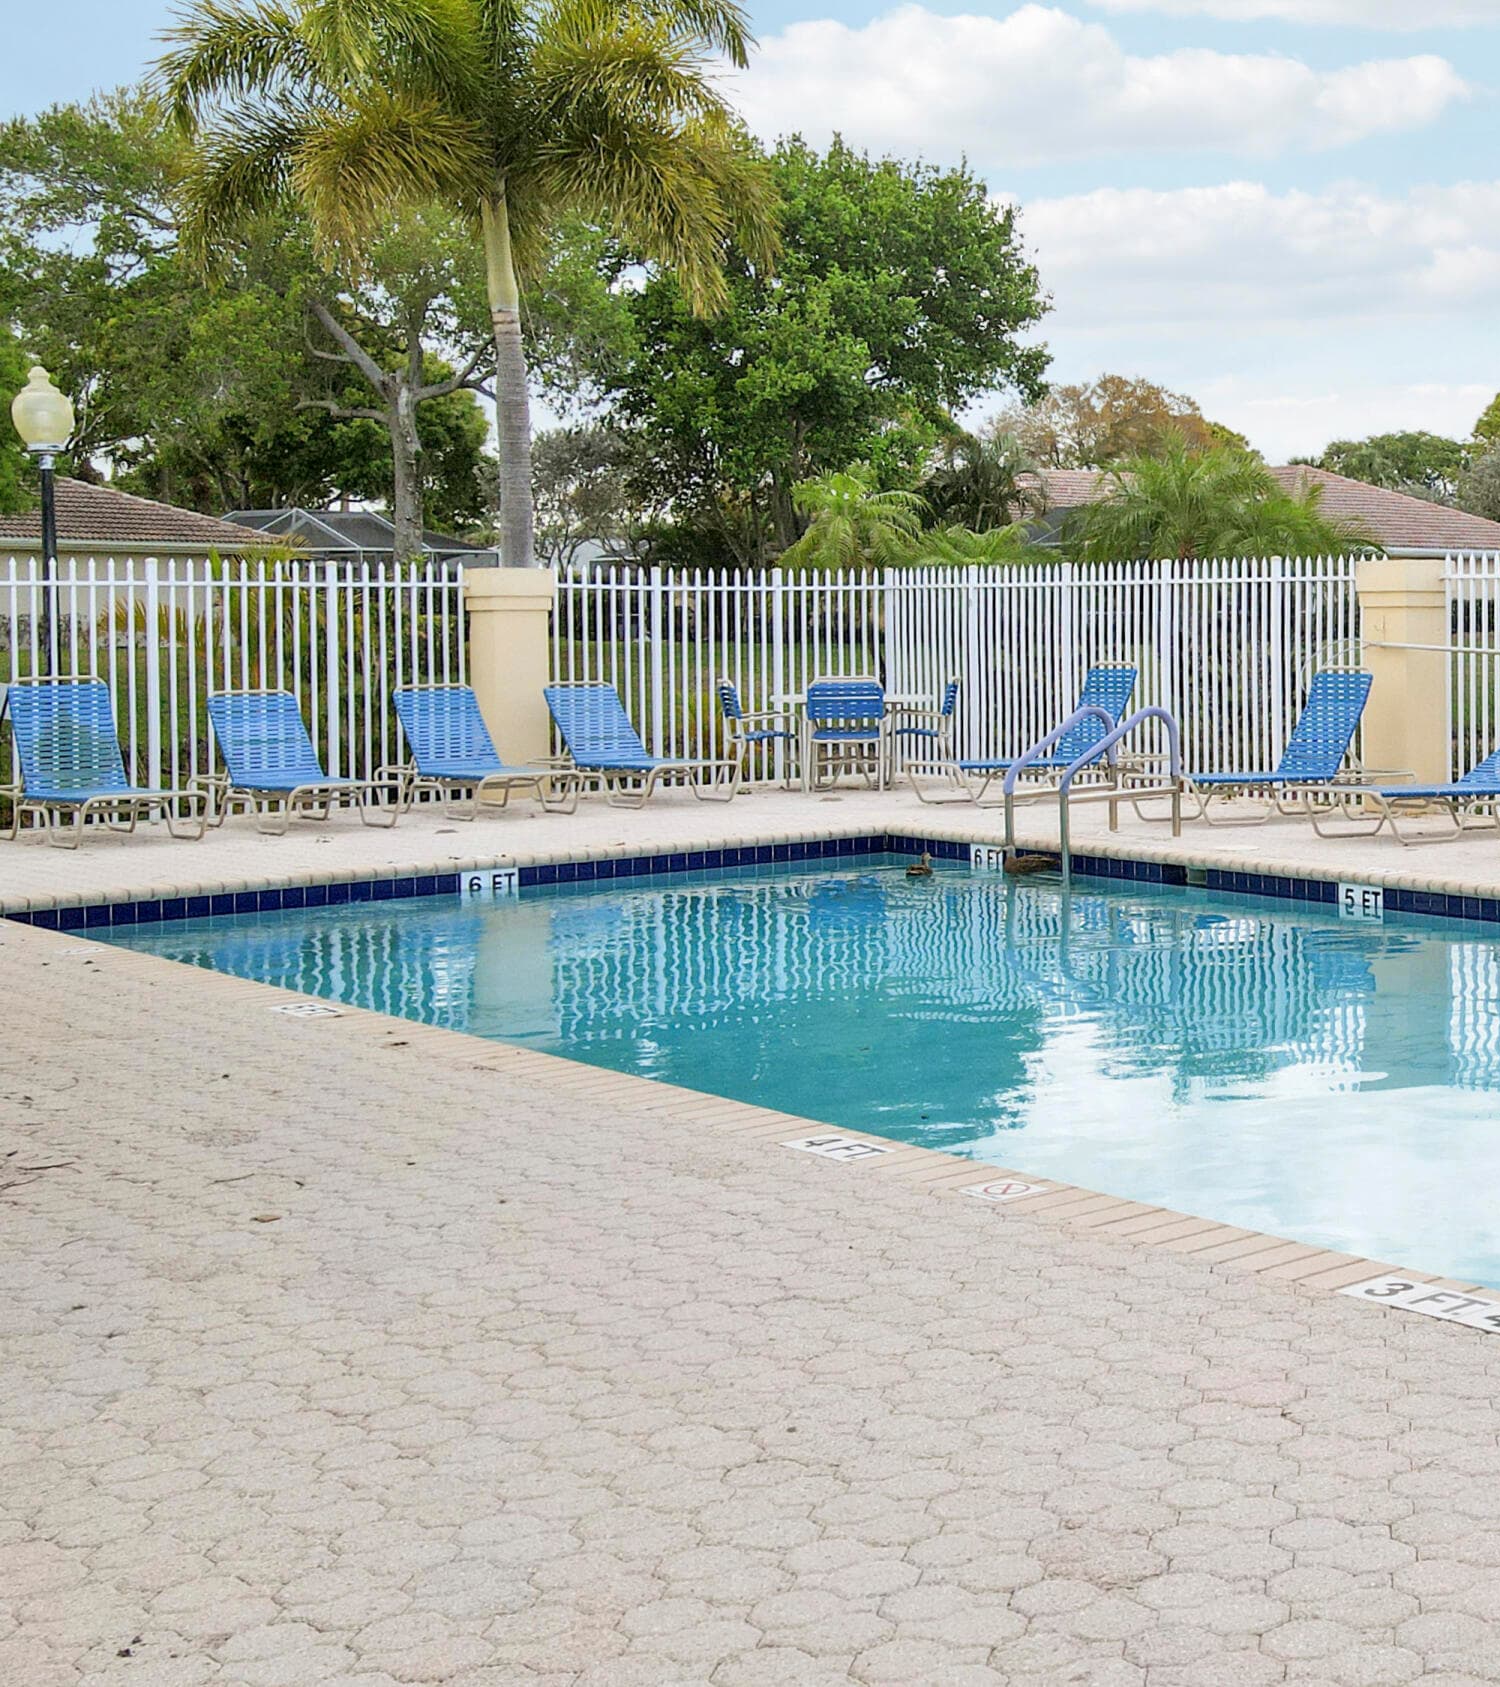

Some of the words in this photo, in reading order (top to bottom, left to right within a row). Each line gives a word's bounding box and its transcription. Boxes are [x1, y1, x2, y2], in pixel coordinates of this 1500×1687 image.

[974, 848, 982, 866] 6
[469, 876, 482, 892] 6
[492, 872, 516, 891] FT
[805, 1138, 843, 1147] 4
[1364, 1282, 1415, 1297] 3
